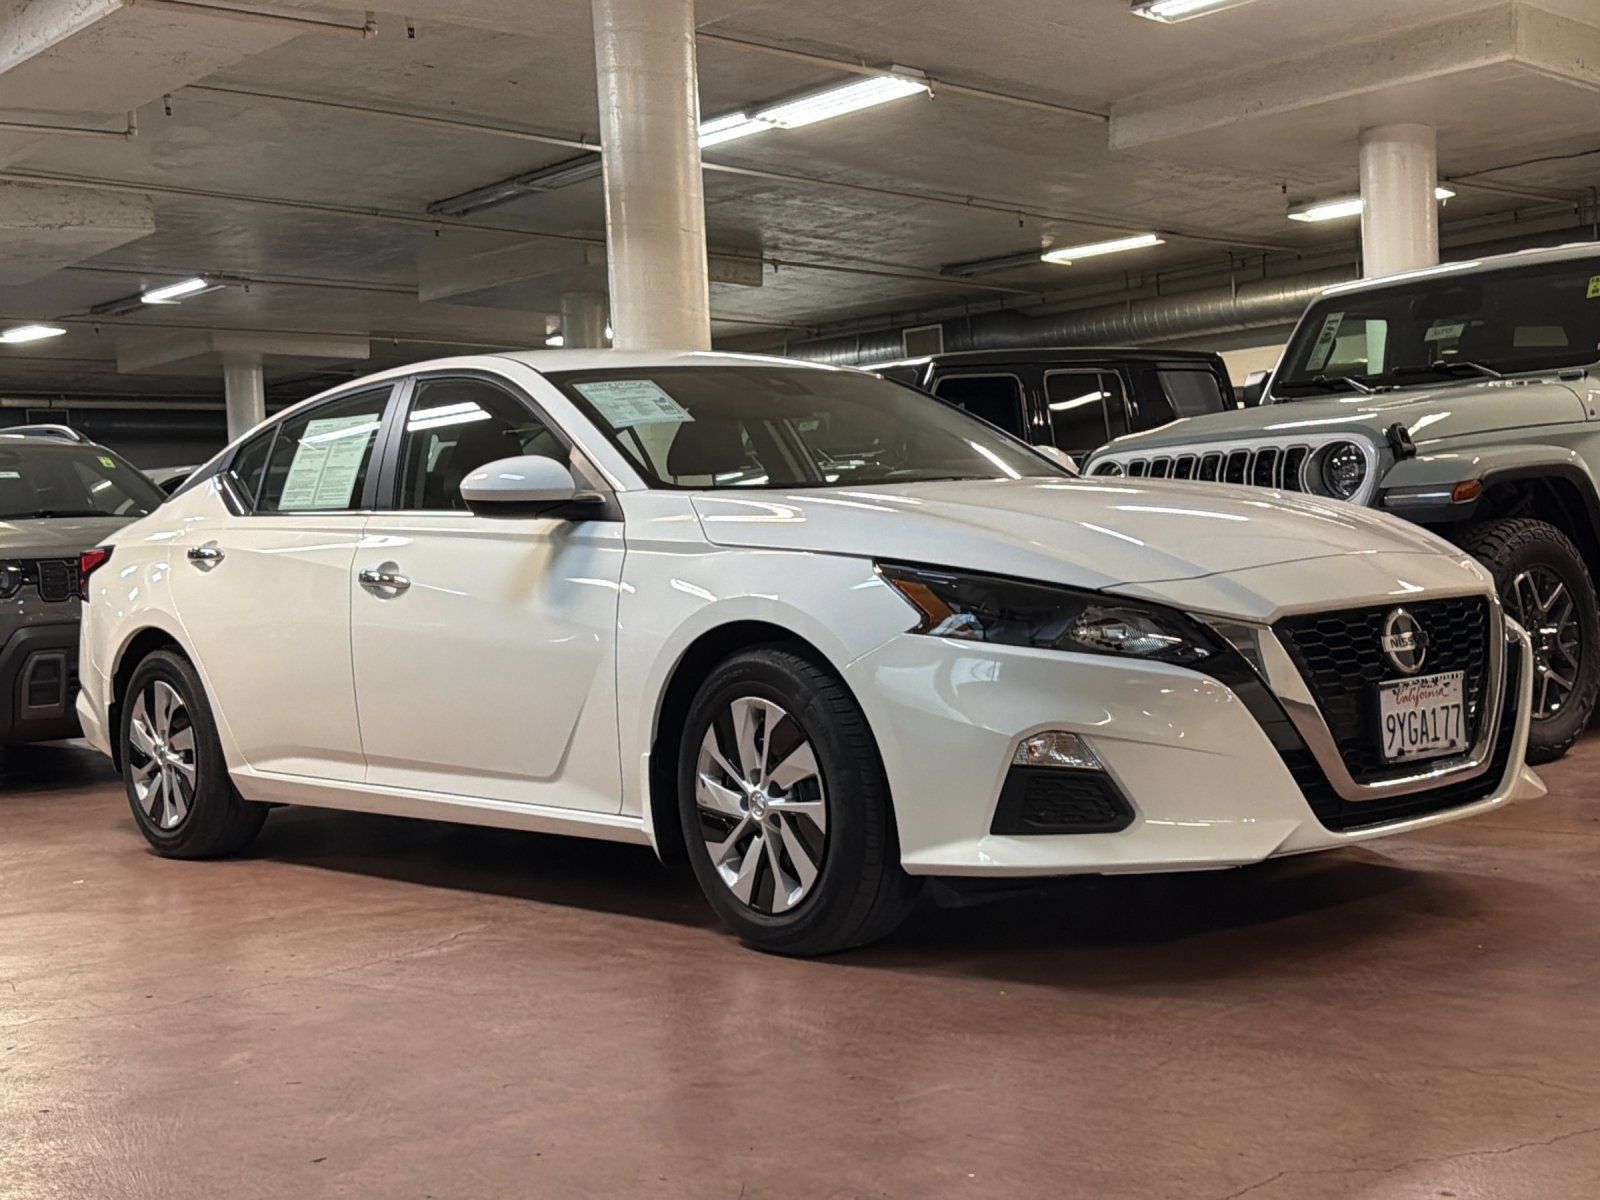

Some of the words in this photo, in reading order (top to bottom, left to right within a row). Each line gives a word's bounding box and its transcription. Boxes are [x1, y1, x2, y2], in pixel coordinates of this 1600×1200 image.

[1390, 635, 1421, 648] NISS
[1395, 686, 1449, 707] California
[1386, 704, 1461, 750] 9YGA177
